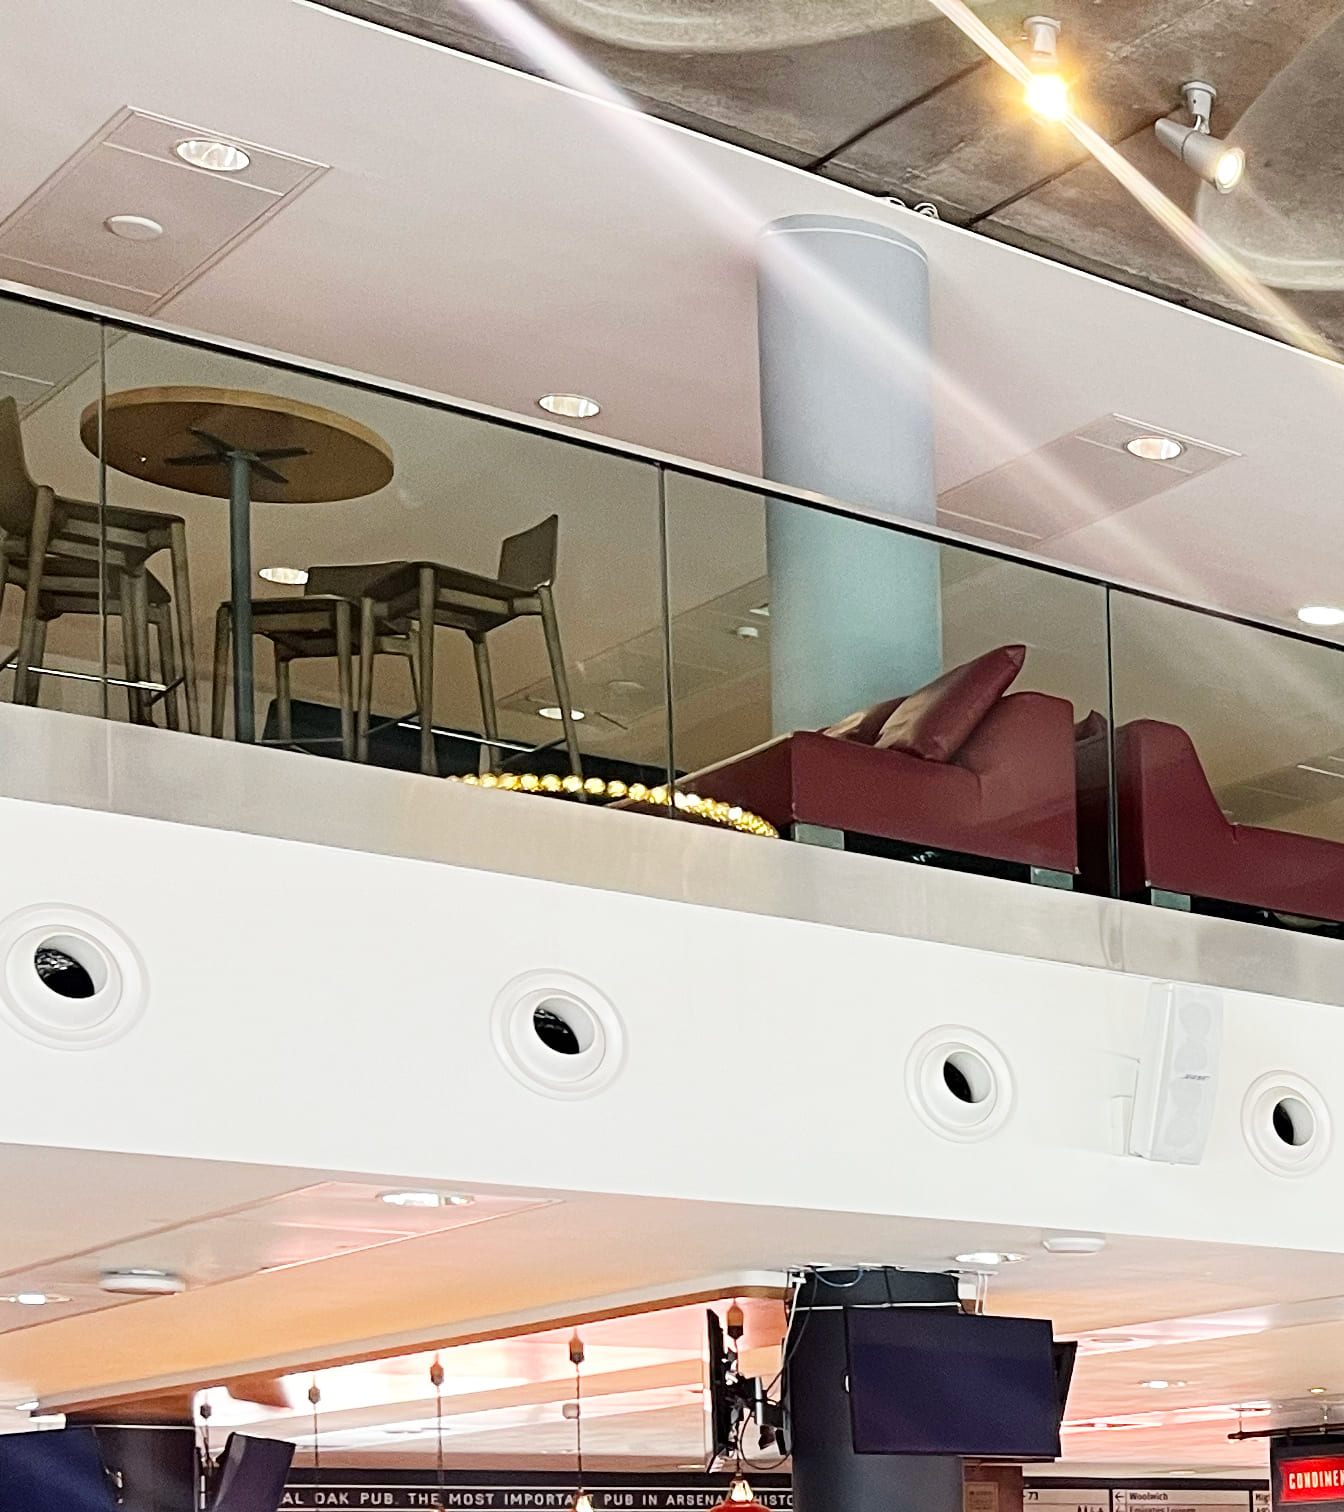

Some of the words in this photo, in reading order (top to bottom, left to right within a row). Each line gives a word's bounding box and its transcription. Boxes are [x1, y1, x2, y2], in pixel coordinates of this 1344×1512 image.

[314, 1492, 349, 1505] OAK
[408, 1493, 439, 1505] THE
[449, 1493, 495, 1506] MOST
[504, 1493, 594, 1506] IMPORTAT
[604, 1494, 634, 1506] PUB
[642, 1494, 658, 1506] IN
[1129, 1492, 1169, 1501] Woolwich
